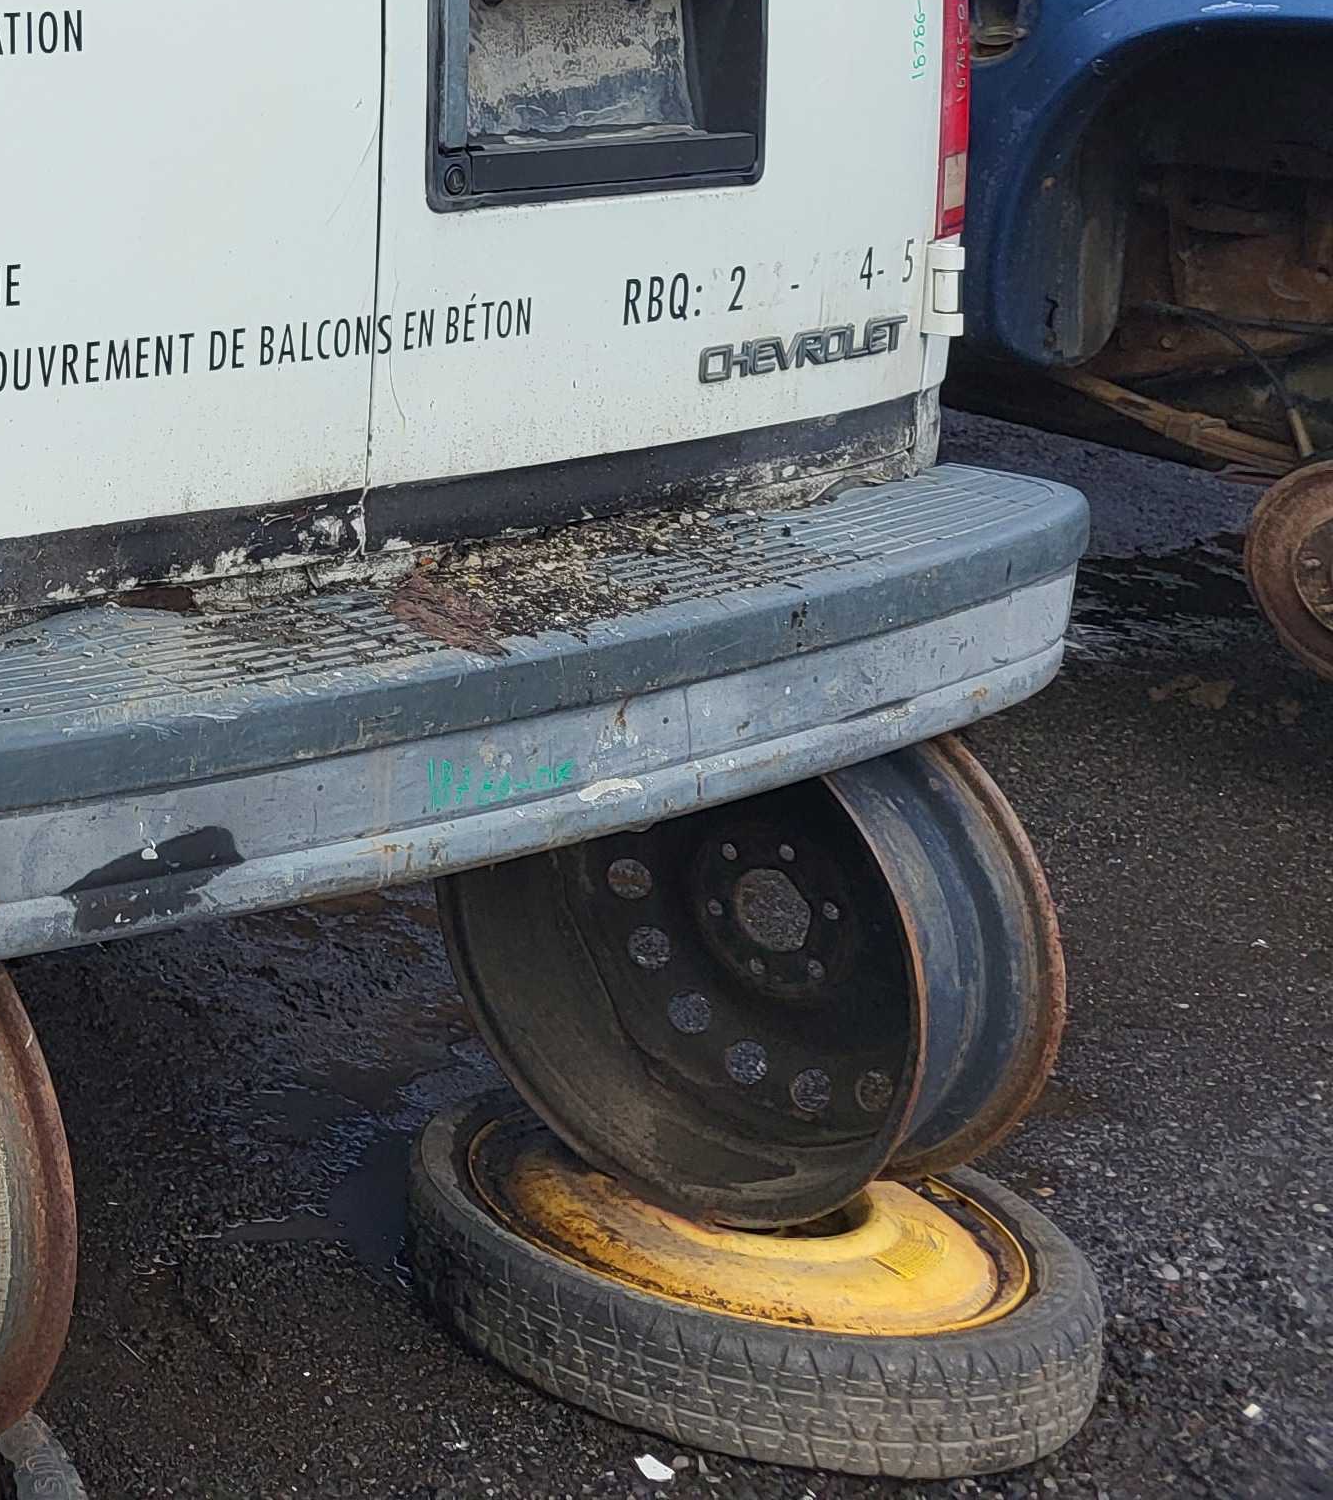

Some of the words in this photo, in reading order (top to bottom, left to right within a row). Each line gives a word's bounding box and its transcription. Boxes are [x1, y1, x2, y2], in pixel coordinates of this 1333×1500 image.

[209, 327, 246, 371] DE
[259, 314, 393, 366] BALCONS
[404, 308, 435, 352] EN
[445, 293, 533, 344] BÉTON
[623, 272, 703, 326] RBQ:
[698, 314, 909, 384] CHEVROLET
